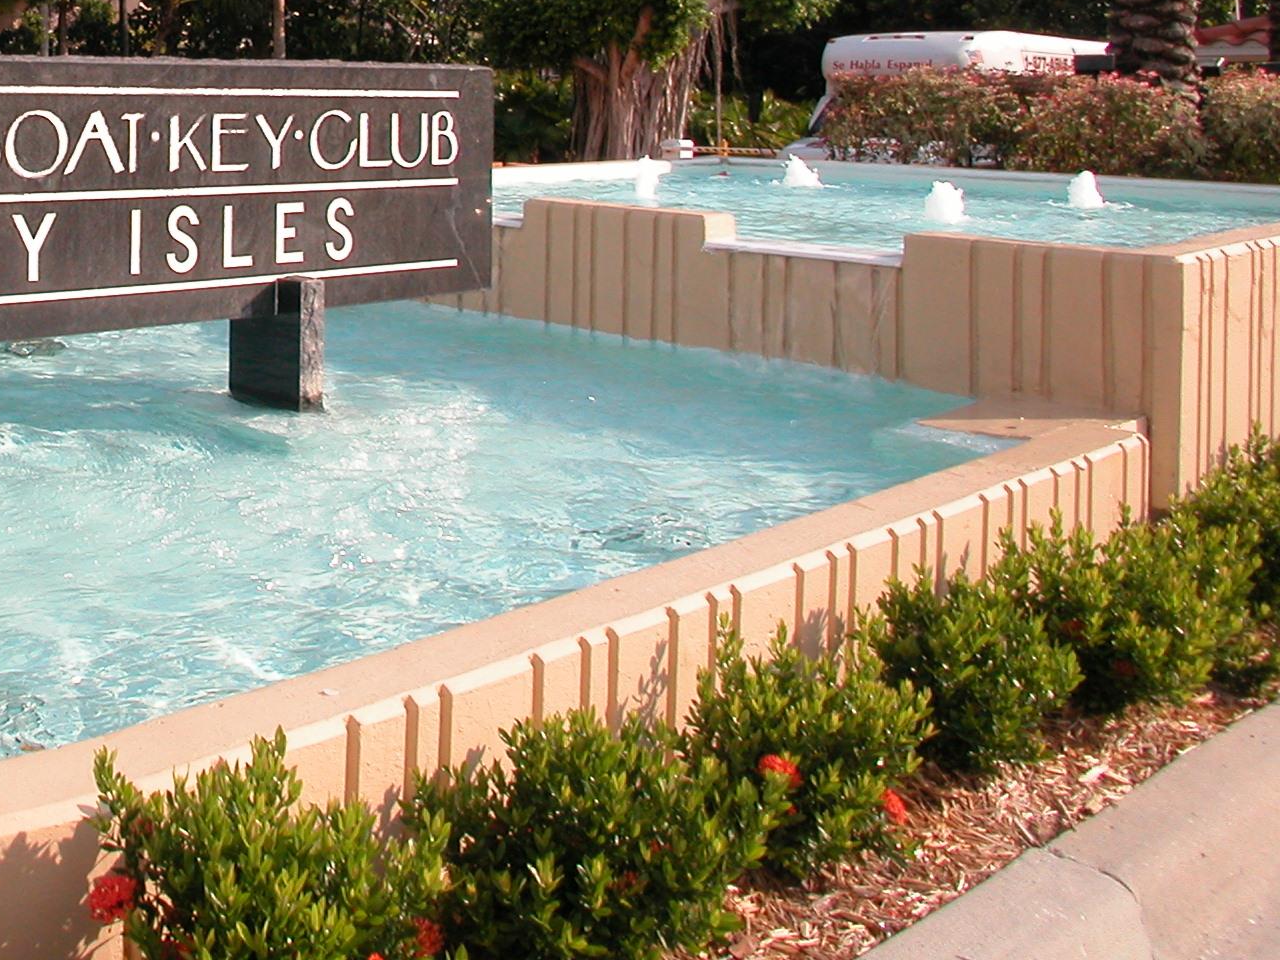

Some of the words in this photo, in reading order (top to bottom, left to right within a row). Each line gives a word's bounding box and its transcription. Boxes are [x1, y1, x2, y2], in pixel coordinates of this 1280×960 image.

[832, 60, 845, 70] Se
[850, 59, 881, 70] Habla
[168, 113, 294, 174] KEY
[309, 108, 459, 170] CLUB
[130, 196, 355, 276] ISLES
